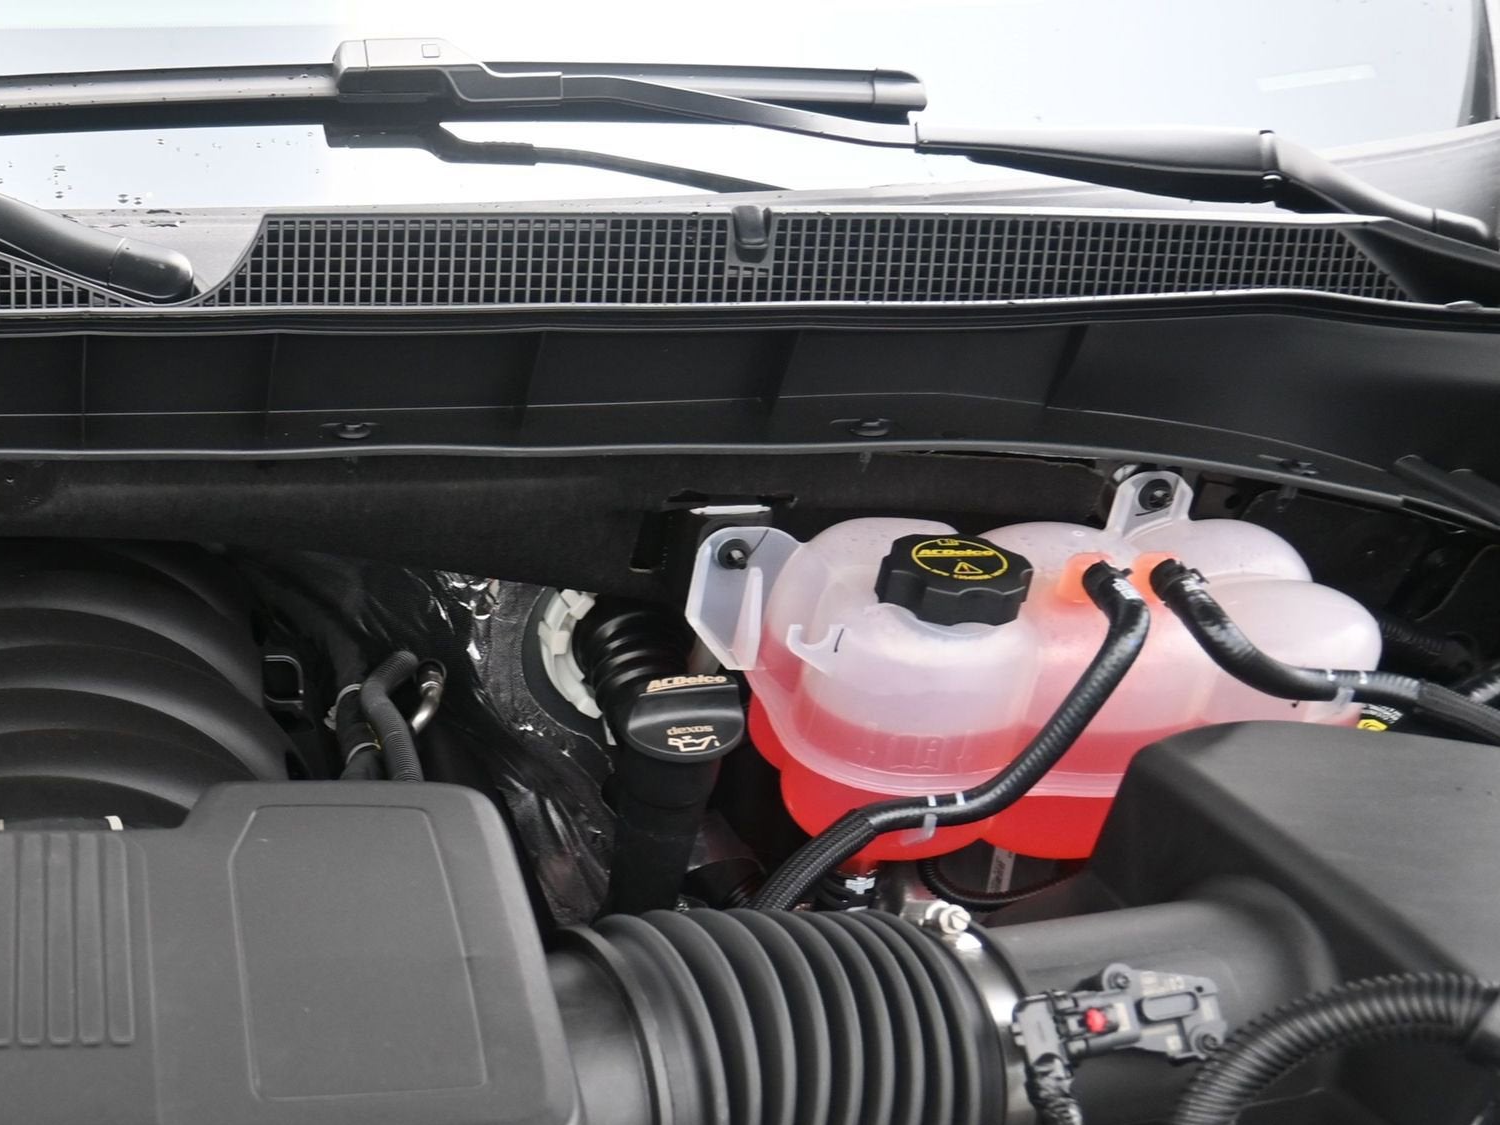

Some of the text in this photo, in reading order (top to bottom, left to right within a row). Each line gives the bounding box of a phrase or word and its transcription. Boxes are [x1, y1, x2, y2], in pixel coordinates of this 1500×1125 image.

[916, 548, 996, 558] ACDelco
[646, 675, 727, 693] ACDelco
[666, 725, 714, 736] dexos
